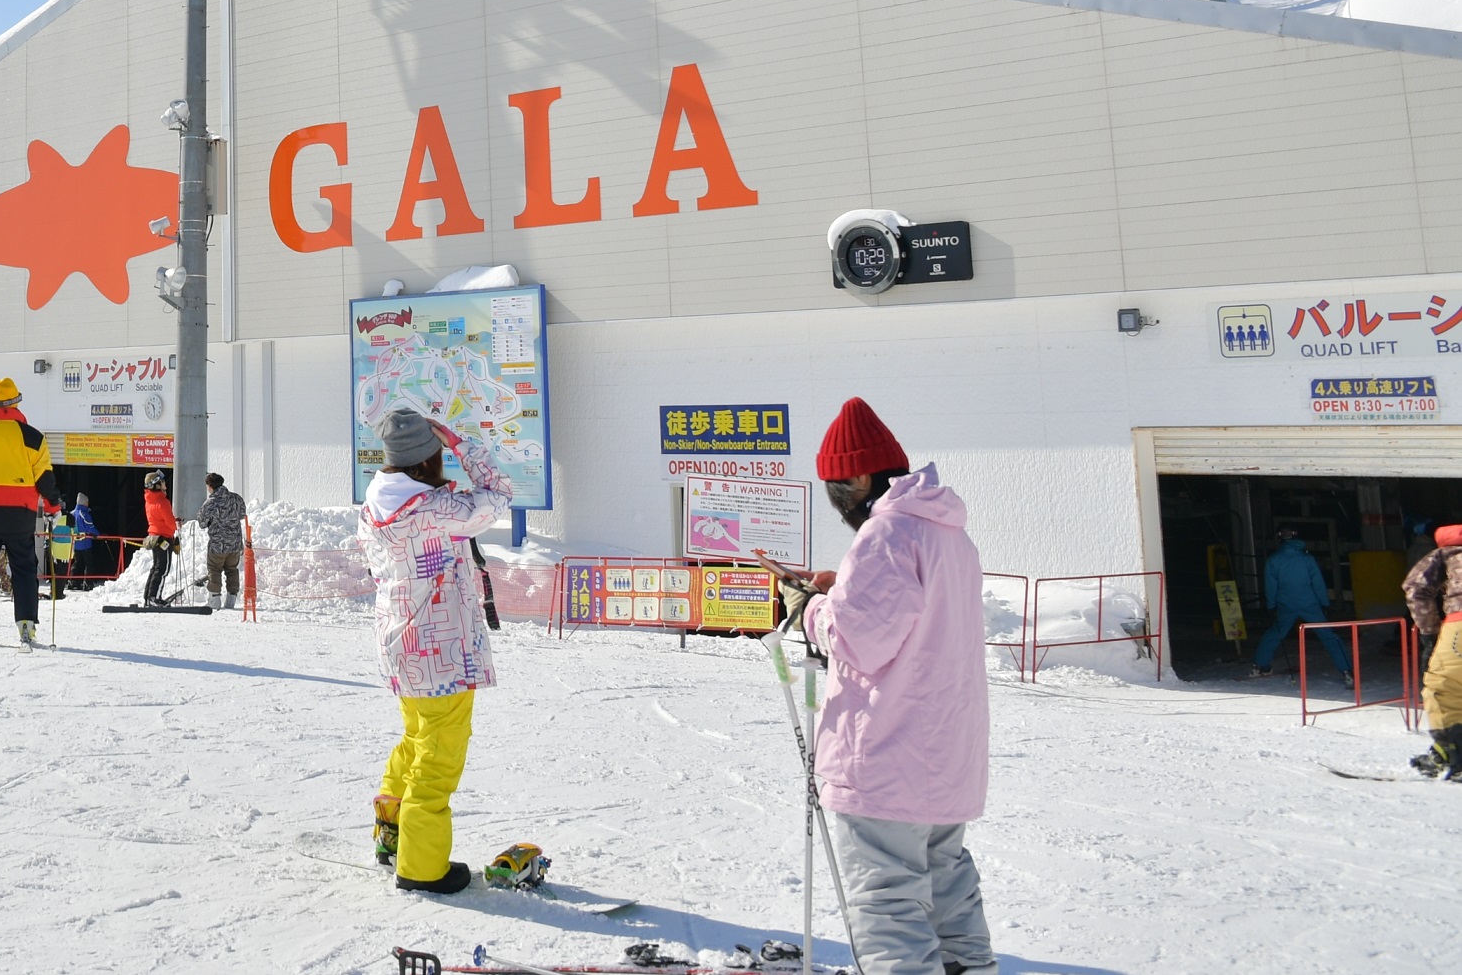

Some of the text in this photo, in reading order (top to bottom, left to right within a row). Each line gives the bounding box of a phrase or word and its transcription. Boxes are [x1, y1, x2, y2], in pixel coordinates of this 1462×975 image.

[268, 63, 759, 253] GALA
[911, 236, 960, 249] SUUNTO
[855, 248, 886, 265] 10:29
[1300, 342, 1353, 358] QUAD
[1360, 340, 1398, 356] LIFT
[86, 357, 167, 383] ソーシャブル
[90, 383, 163, 393] QUAD LIFT Sociable
[1314, 379, 1434, 396] 4人乗り高速リフト
[1313, 400, 1349, 412] OPEN
[1354, 400, 1382, 412] 8:30
[1399, 399, 1435, 412] 17:00
[666, 410, 784, 436] 徒歩乗車口
[137, 448, 144, 456] by
[664, 439, 788, 451] Non-Skier/Non-Snowboarder Entrance
[669, 460, 702, 475] OPEN
[768, 549, 789, 558] GALA
